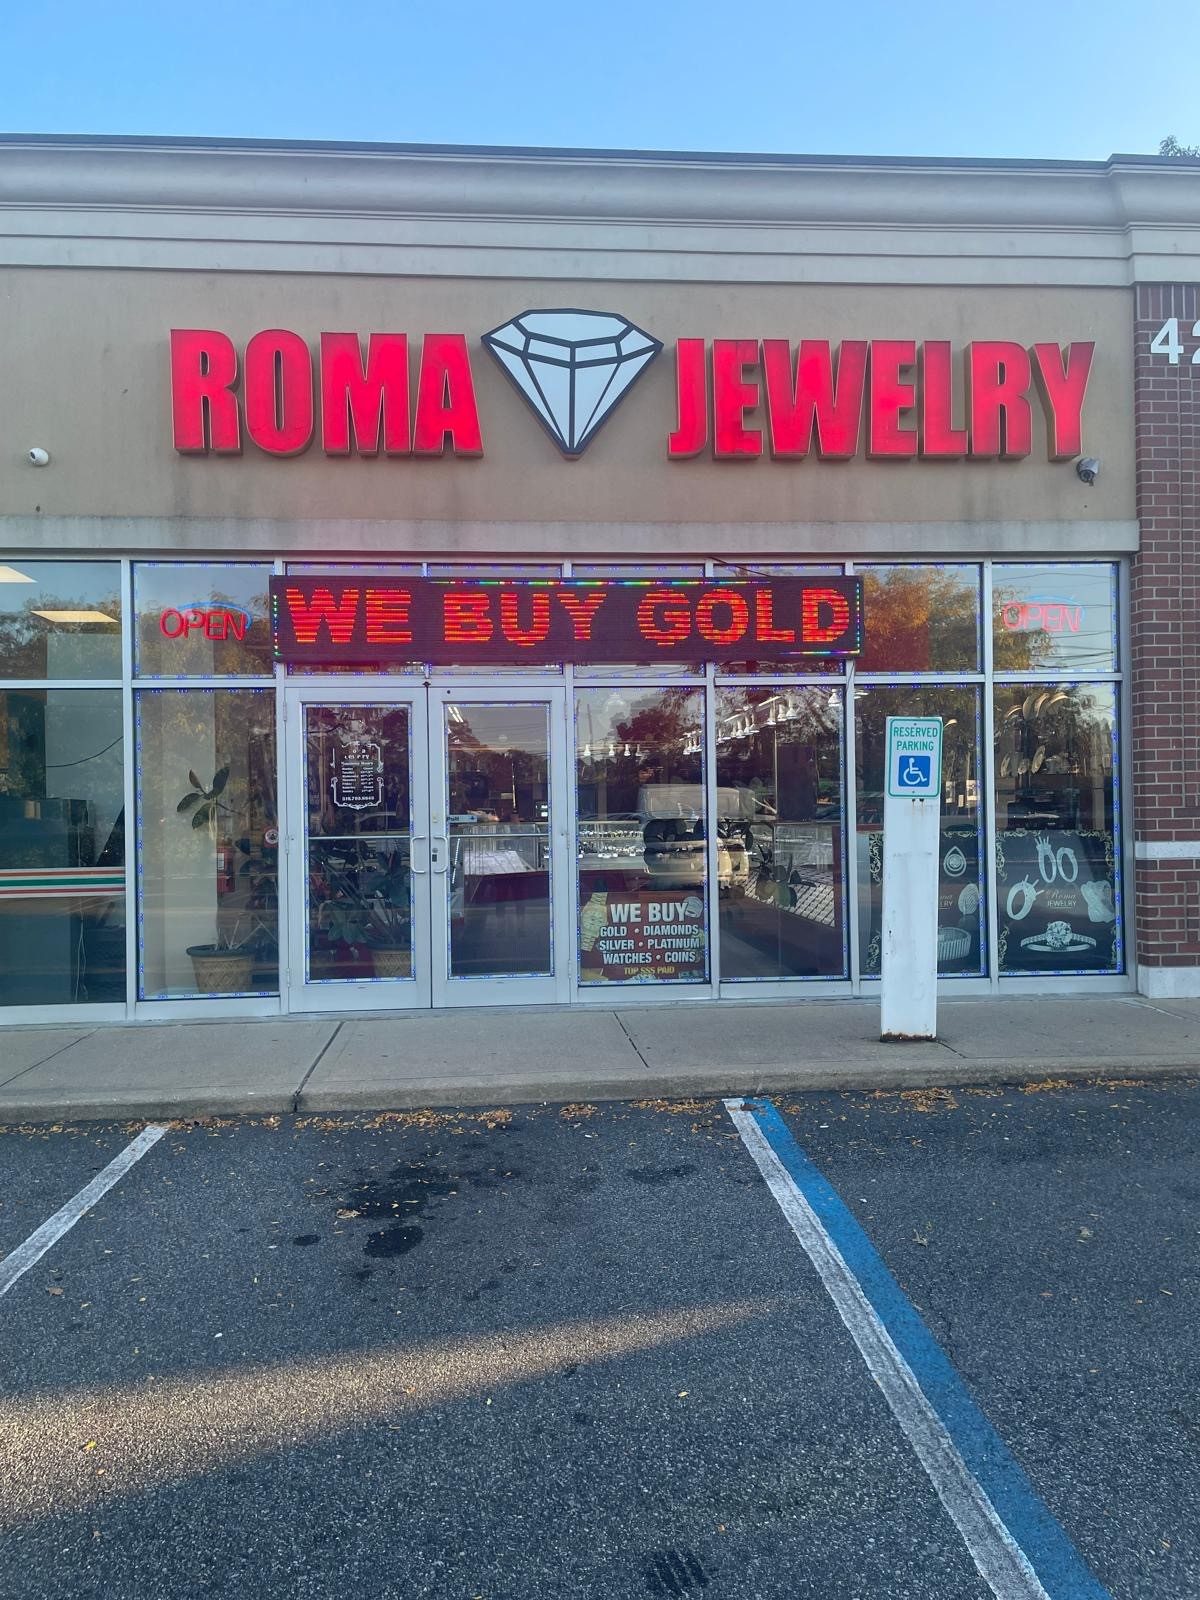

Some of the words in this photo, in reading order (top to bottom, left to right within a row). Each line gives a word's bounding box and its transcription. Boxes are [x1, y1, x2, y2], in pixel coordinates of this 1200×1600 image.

[1150, 317, 1200, 364] 4
[170, 328, 484, 458] ROMA
[668, 337, 1096, 461] JEWELRY
[286, 588, 412, 643] WE
[444, 592, 607, 647] BUY
[637, 588, 850, 646] GOLD
[1003, 601, 1081, 632] OPEN
[159, 607, 247, 641] OPEN
[893, 726, 938, 738] RESERVED
[896, 740, 934, 752] PARKING
[1047, 900, 1077, 908] JEWELRY
[610, 903, 642, 923] WE
[648, 902, 689, 922] BUY
[600, 926, 627, 937] GOLD
[643, 924, 699, 936] DIAMONDS
[599, 939, 635, 951] SILVER
[647, 938, 700, 950] PLATINUM
[602, 952, 653, 965] WATCHES
[664, 951, 696, 963] COINS
[623, 966, 639, 975] TOP
[657, 965, 675, 975] PAID
